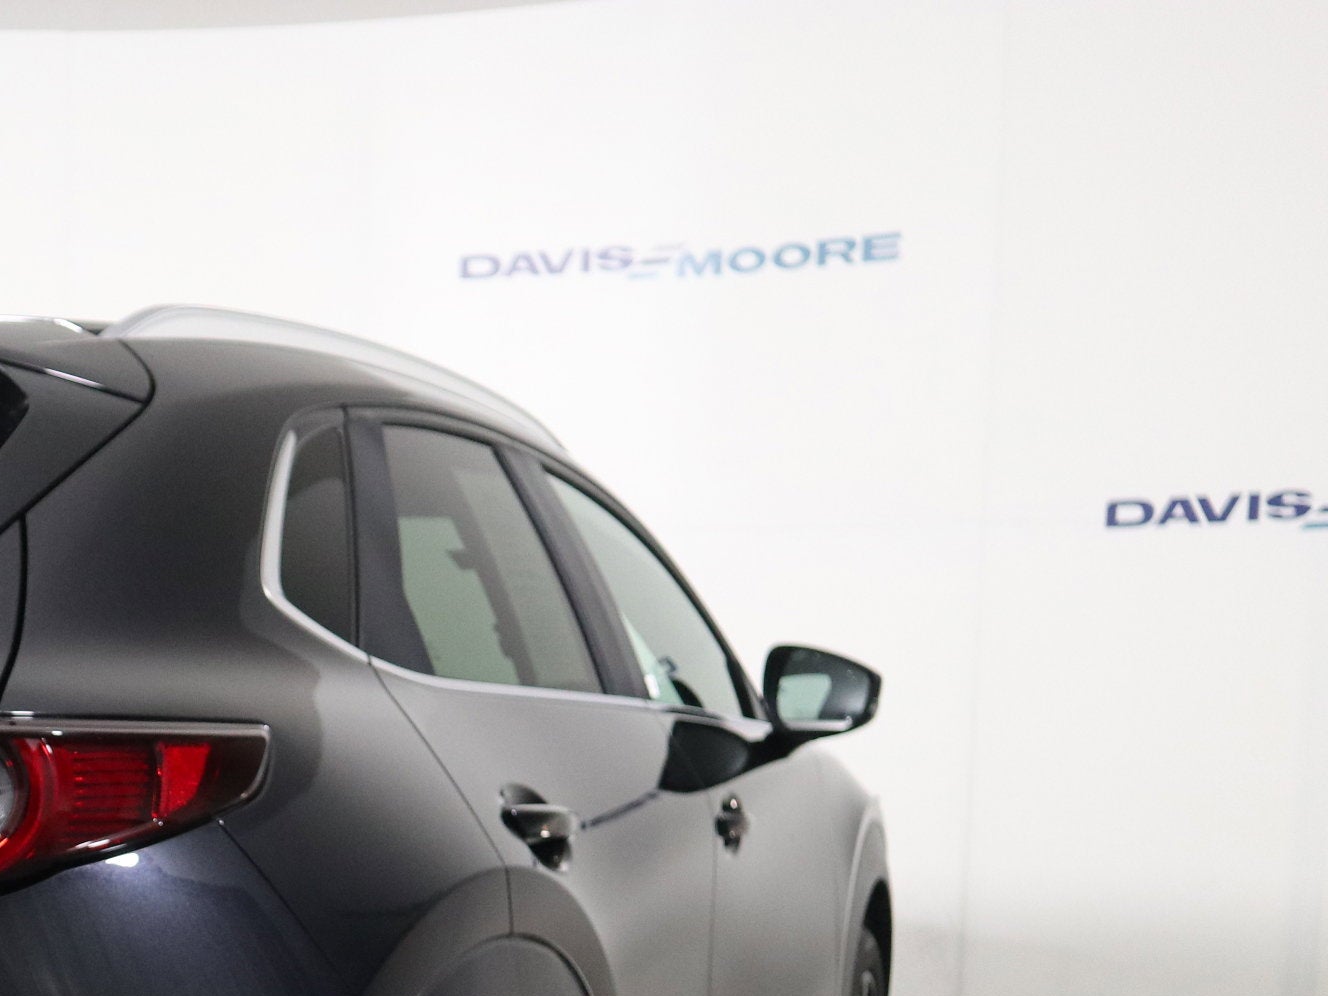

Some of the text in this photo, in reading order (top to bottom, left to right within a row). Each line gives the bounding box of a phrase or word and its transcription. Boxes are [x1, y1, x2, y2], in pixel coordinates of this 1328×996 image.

[459, 231, 902, 280] DAVIS MOORE
[1105, 489, 1312, 528] DAVIS
